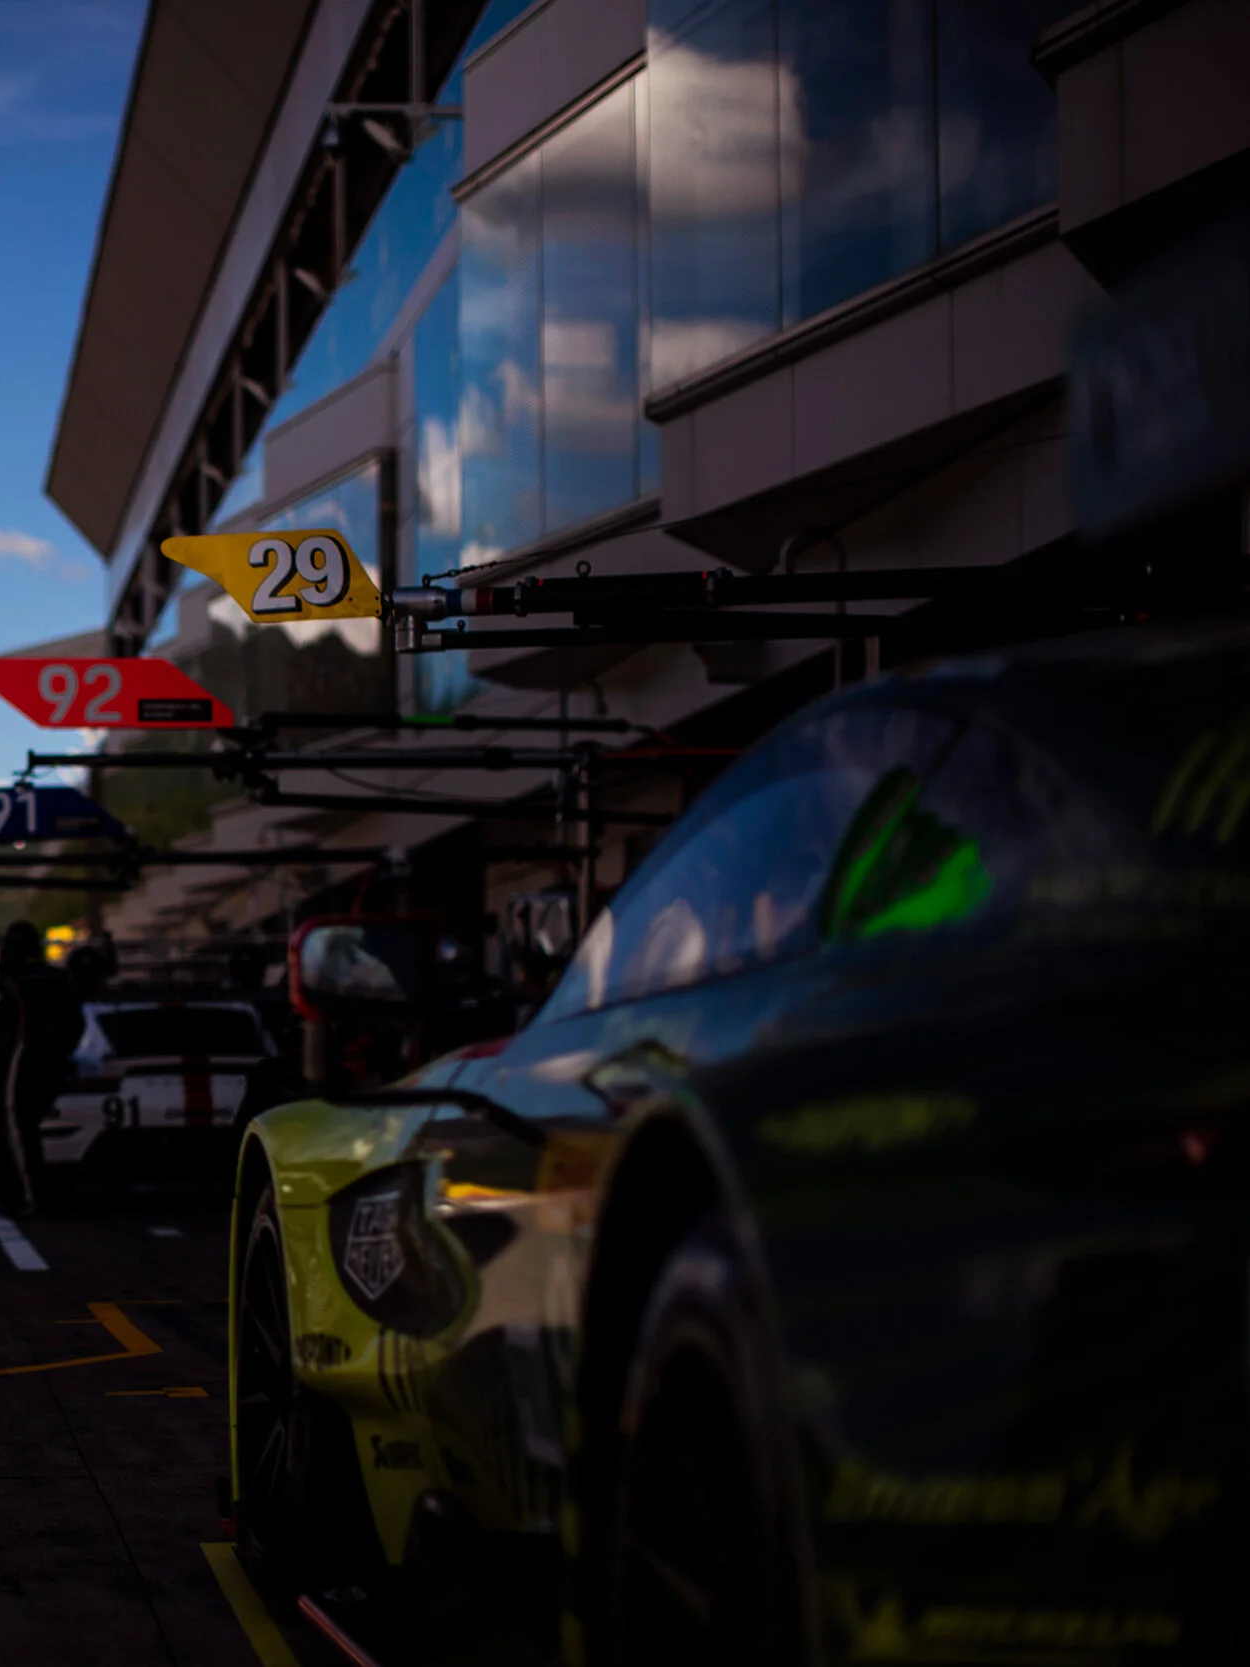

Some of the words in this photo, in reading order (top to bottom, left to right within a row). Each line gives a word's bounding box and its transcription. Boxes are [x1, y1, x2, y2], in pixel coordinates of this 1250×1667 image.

[249, 534, 351, 615] 29
[38, 663, 122, 723] 92
[102, 1094, 141, 1128] 91
